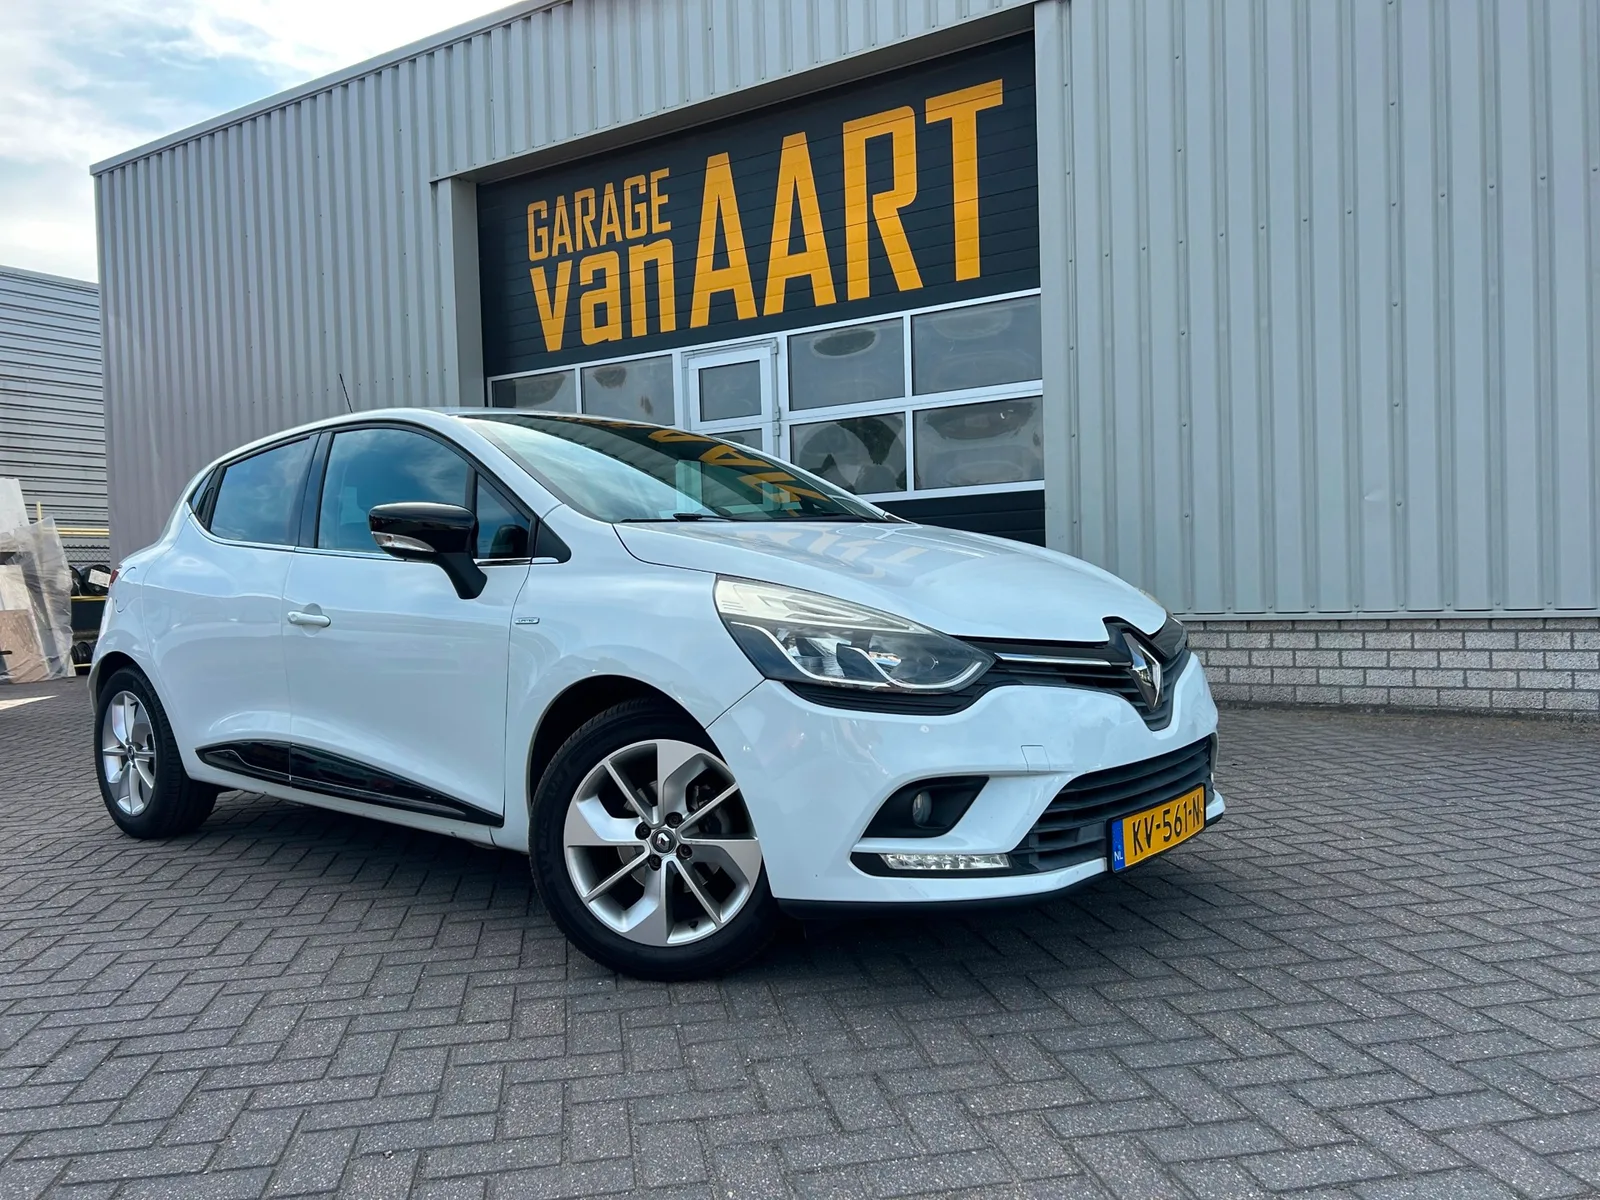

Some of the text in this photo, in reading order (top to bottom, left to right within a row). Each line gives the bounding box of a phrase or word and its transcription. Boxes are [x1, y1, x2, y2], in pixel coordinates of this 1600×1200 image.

[527, 167, 671, 262] GARAGE
[529, 79, 1003, 352] van AART
[1114, 851, 1123, 861] NL
[1132, 794, 1200, 856] KV-561-N
